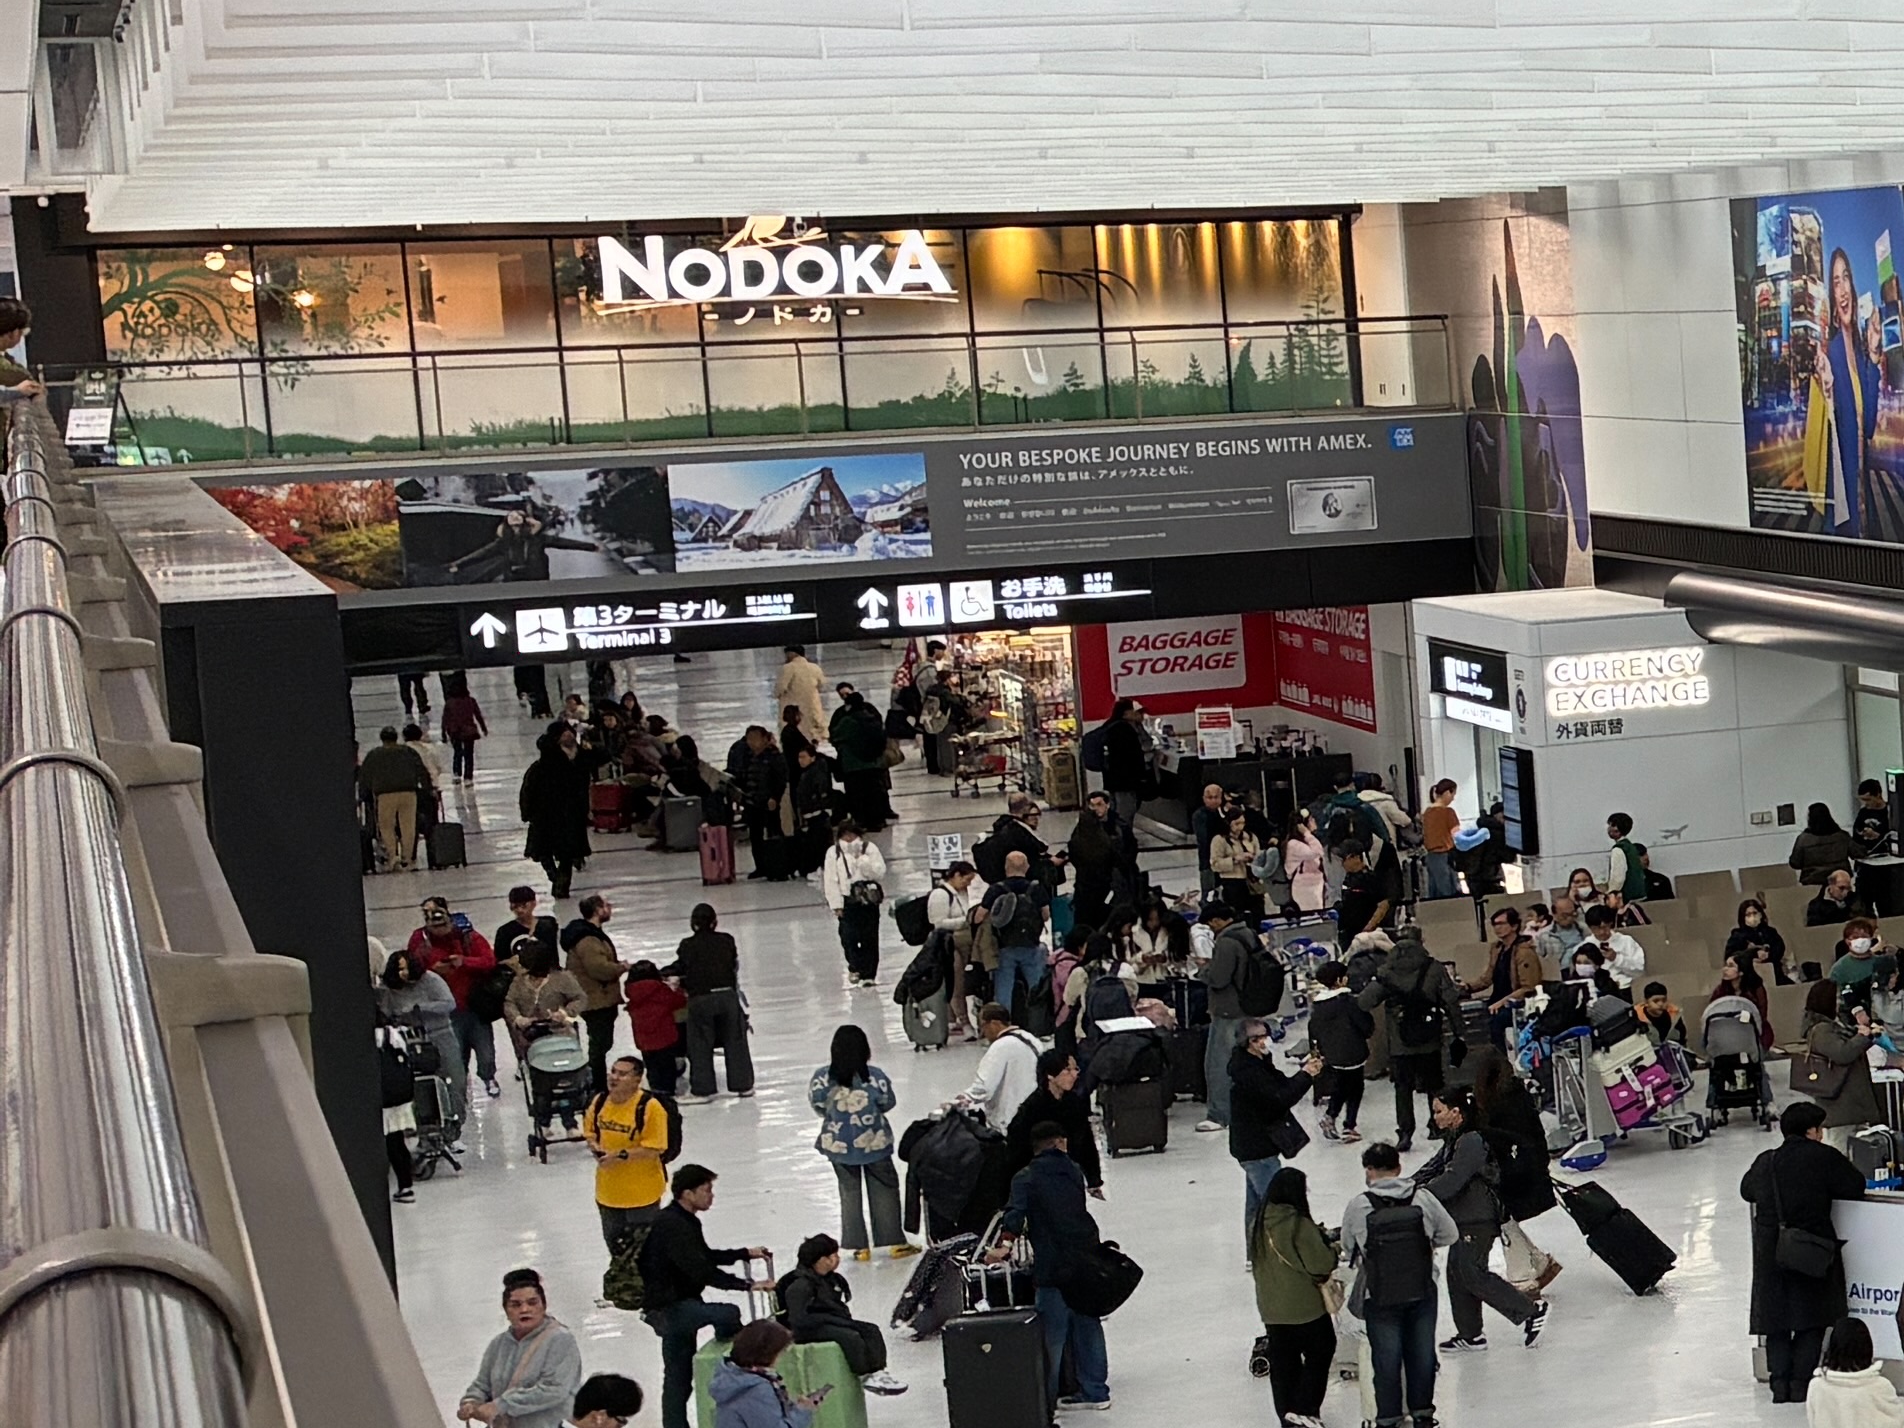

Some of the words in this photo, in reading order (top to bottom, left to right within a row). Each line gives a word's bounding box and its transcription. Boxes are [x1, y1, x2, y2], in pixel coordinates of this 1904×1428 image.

[960, 452, 1013, 470] YOUR
[1019, 447, 1102, 467] BESPOKE
[1107, 442, 1190, 463] JOURNEY
[1196, 439, 1261, 458] BEGINS
[1266, 437, 1311, 453] WITH
[1317, 433, 1372, 450] AMEX.
[964, 497, 1011, 508] Welcome
[1004, 602, 1057, 619] Toilets
[576, 629, 655, 650] Terminal
[660, 628, 672, 645] 3
[1119, 629, 1237, 654] BAGGAGE
[1118, 652, 1239, 677] STORAGE
[1555, 651, 1700, 682] CURRENCY
[1556, 680, 1708, 711] EXCHANGE
[1849, 1282, 1899, 1304] Airpor
